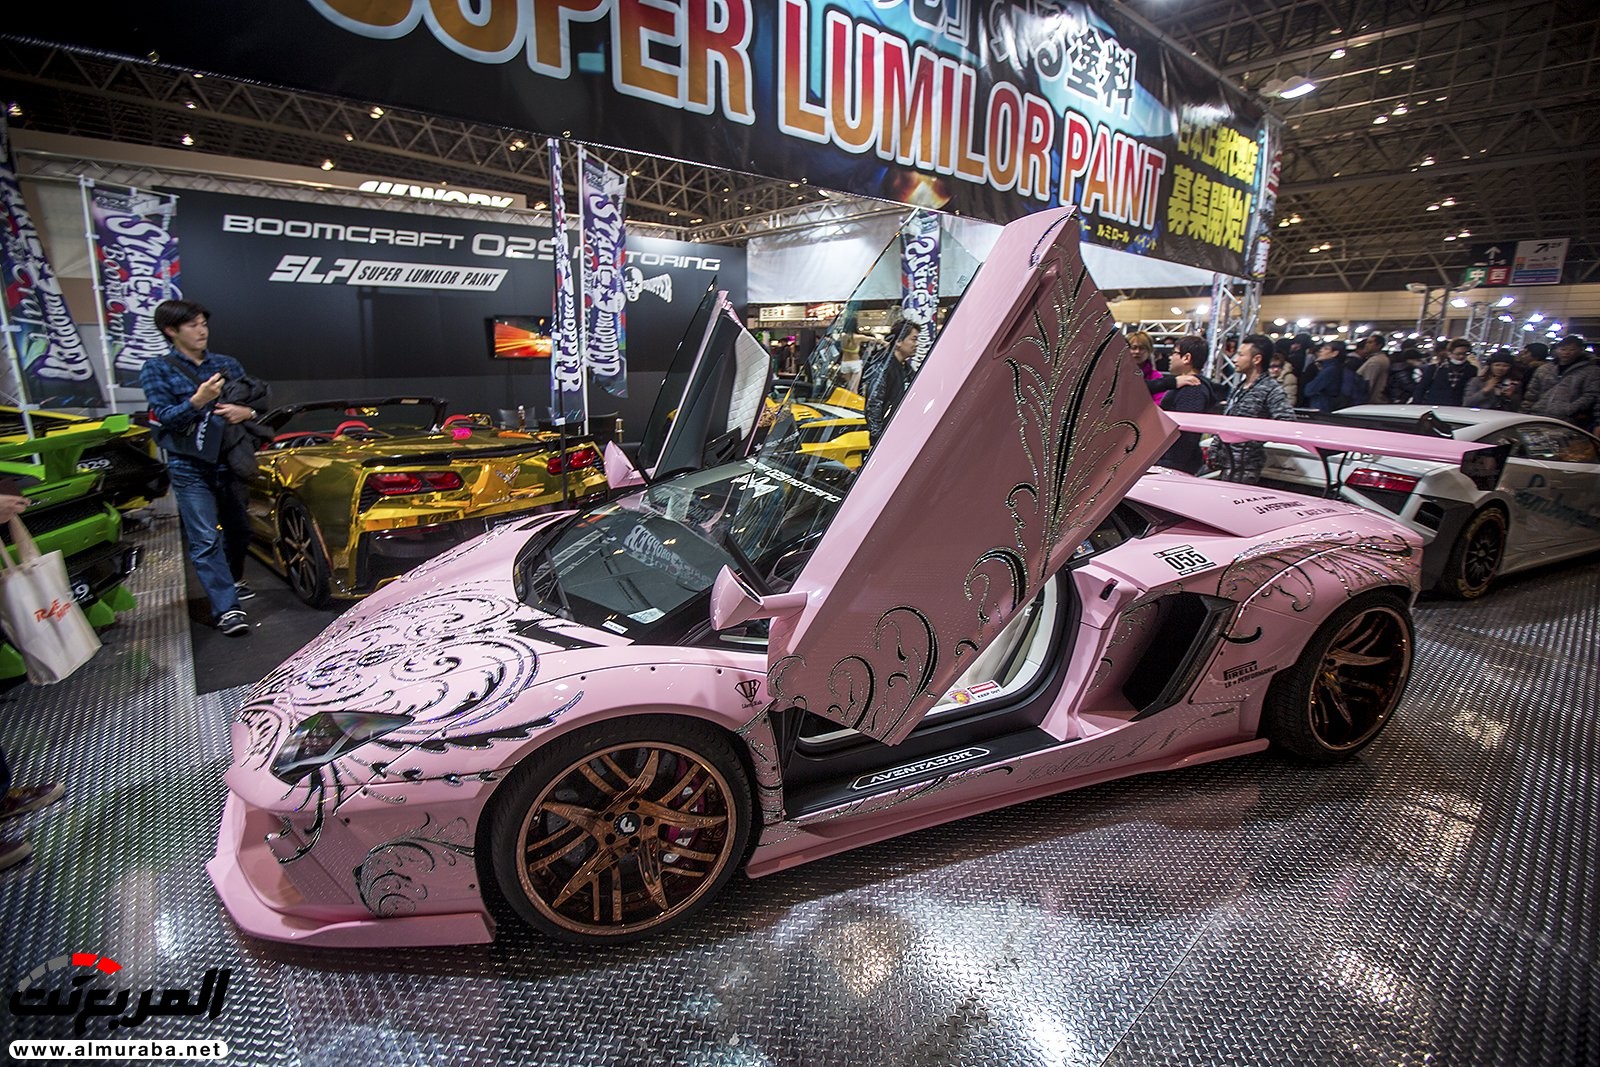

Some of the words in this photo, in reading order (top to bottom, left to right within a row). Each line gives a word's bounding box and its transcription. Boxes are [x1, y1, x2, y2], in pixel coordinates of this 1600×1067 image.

[312, 0, 756, 125] PER
[778, 0, 1054, 201] LUMILOR
[1058, 107, 1166, 229] PAINT
[222, 214, 464, 250] BOOMCRAFT
[358, 266, 401, 283] SUPER
[404, 268, 458, 285] LUMILOR
[462, 271, 499, 287] PAINT
[1164, 550, 1209, 571] 055
[870, 750, 974, 783] AVENTADOR
